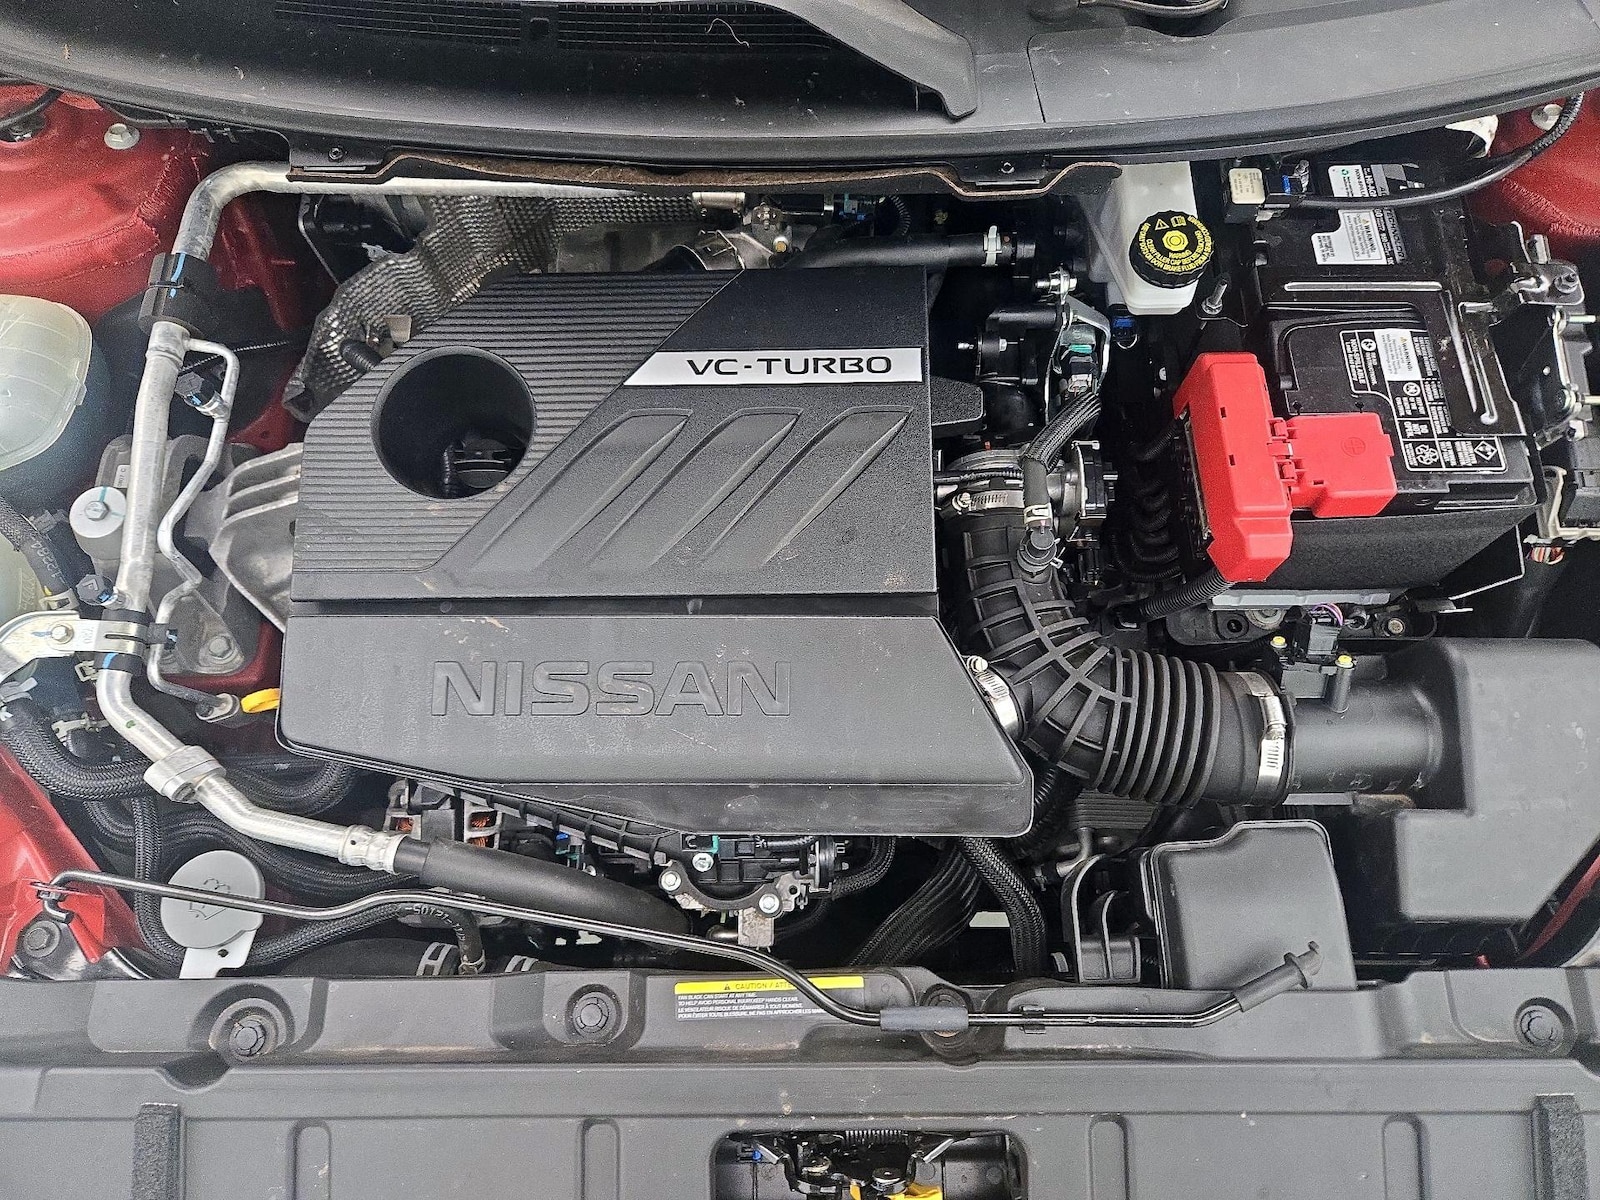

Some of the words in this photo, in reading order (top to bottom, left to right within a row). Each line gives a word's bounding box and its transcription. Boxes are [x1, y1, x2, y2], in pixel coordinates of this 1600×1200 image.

[686, 355, 892, 376] VC-TURBO
[1350, 338, 1366, 384] NON-SPILLABLE
[431, 660, 791, 716] NISSAN
[735, 982, 767, 990] CAUTION
